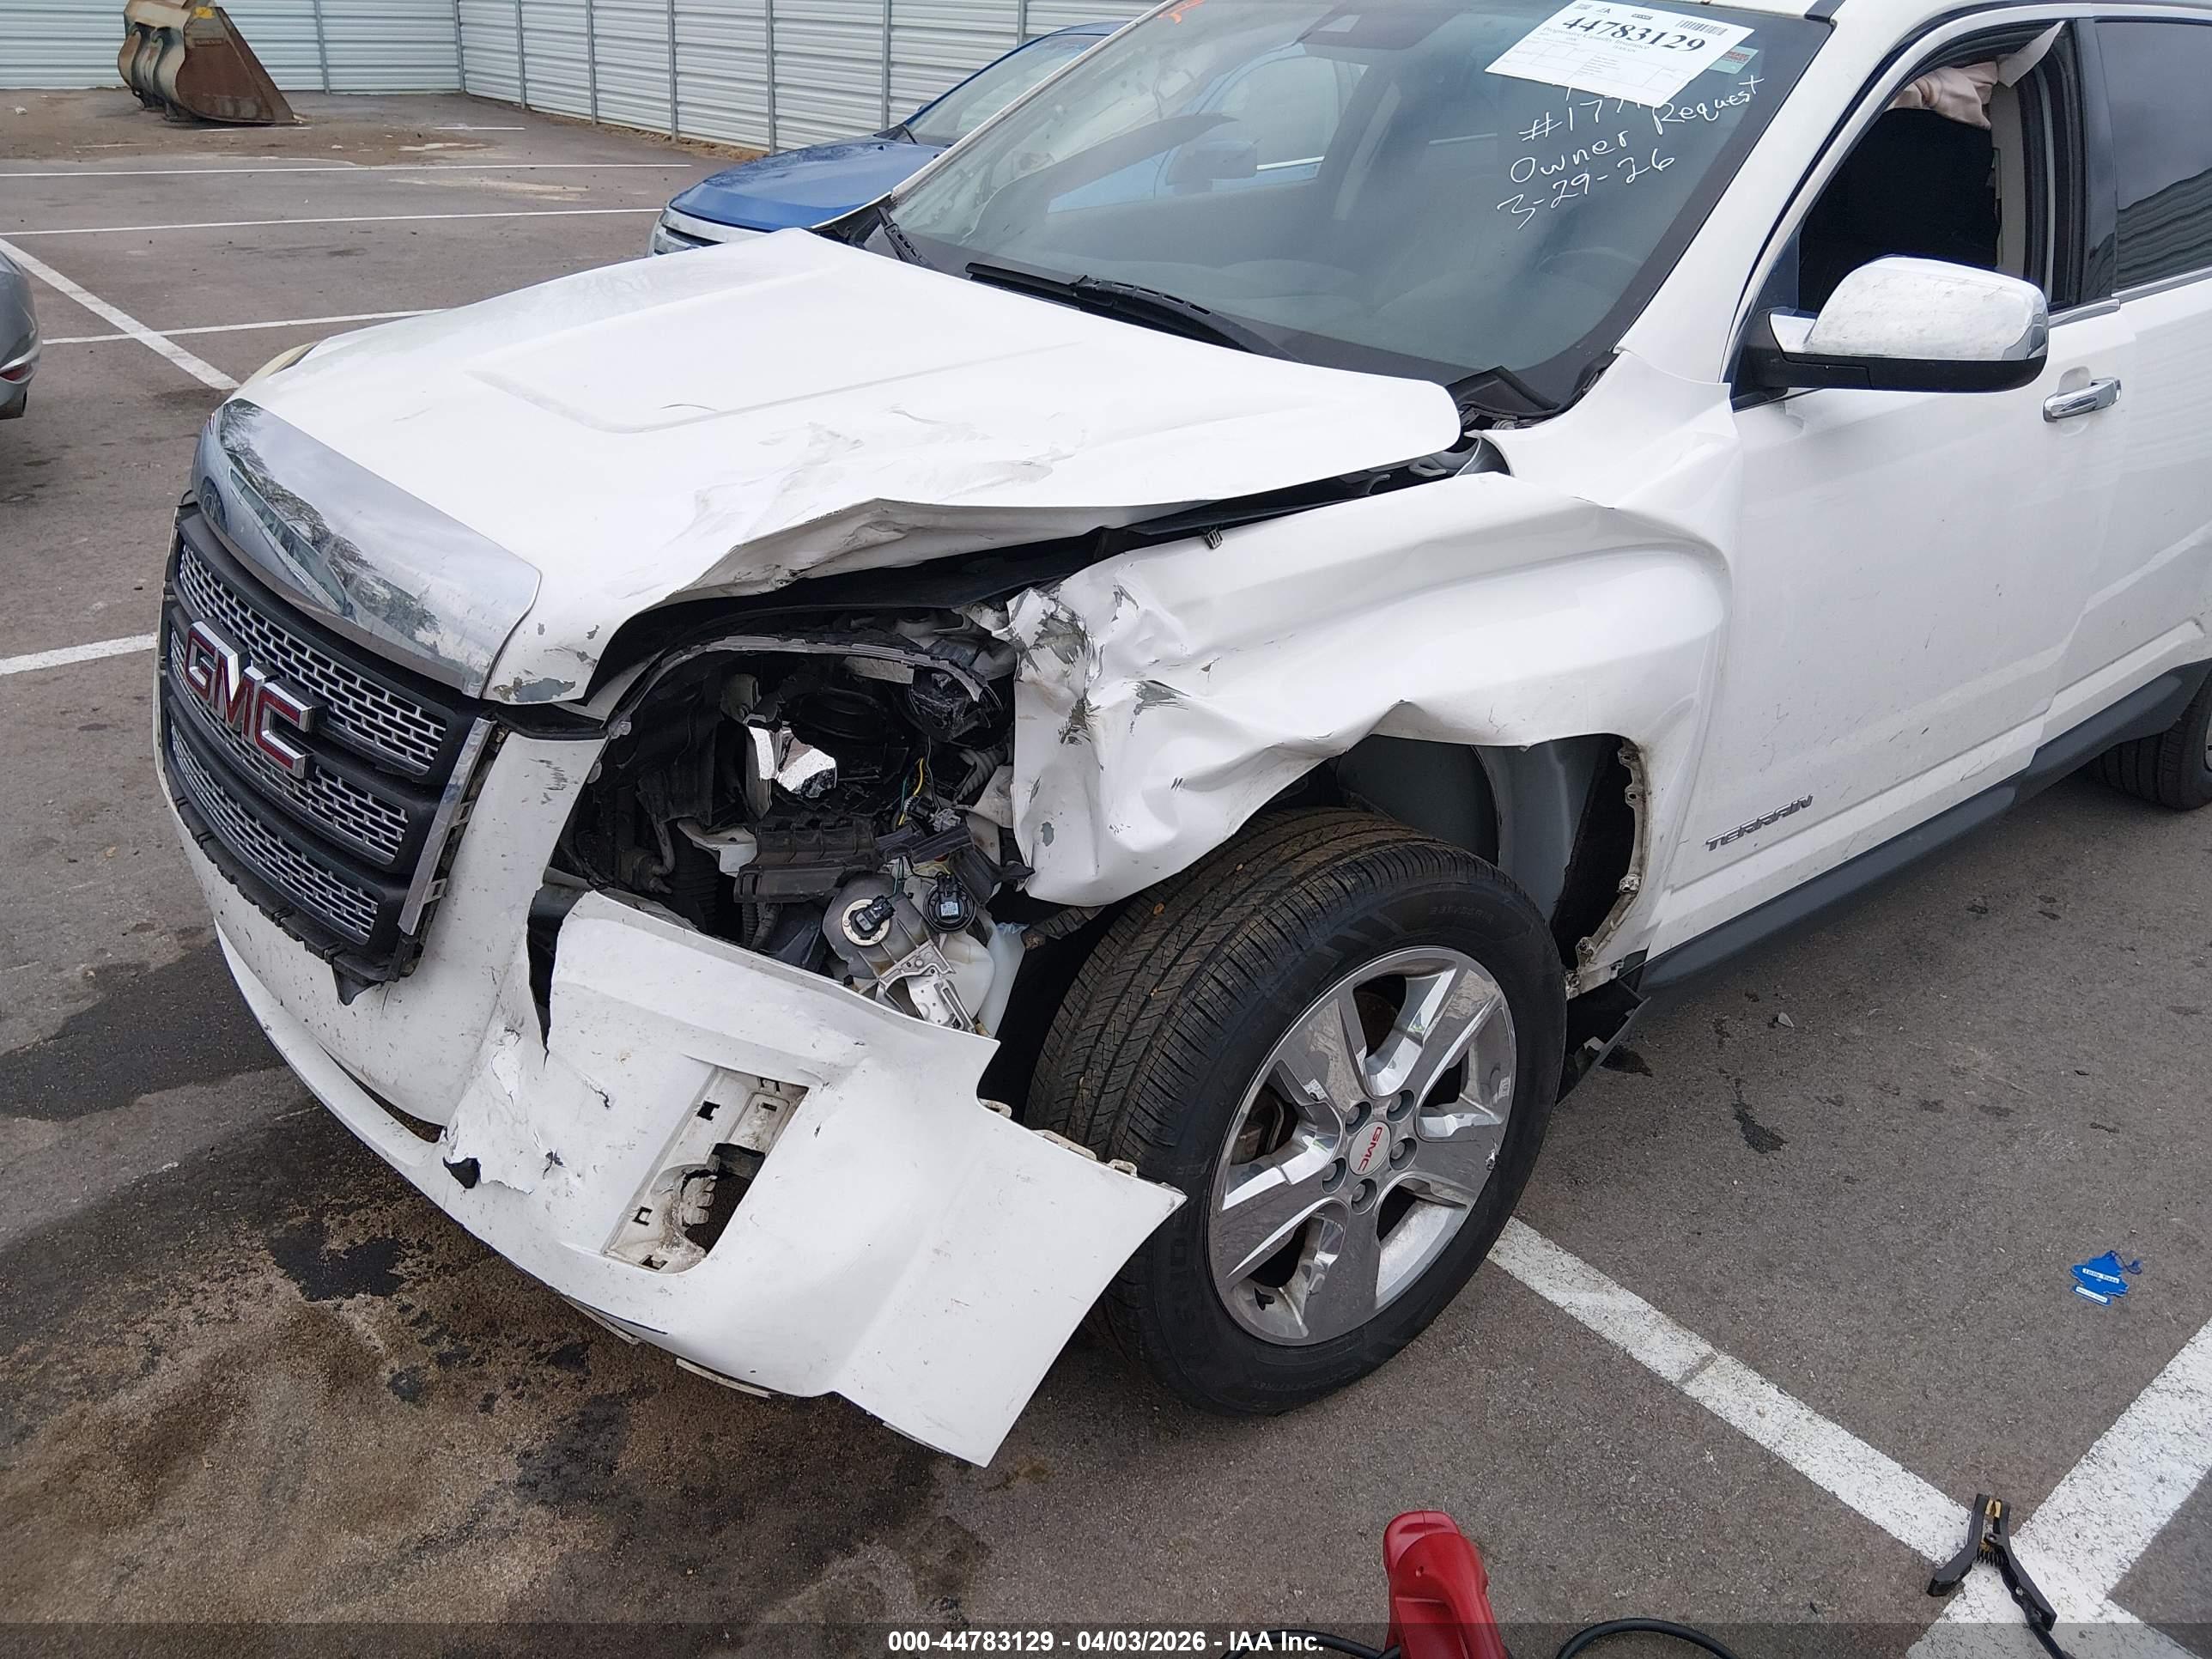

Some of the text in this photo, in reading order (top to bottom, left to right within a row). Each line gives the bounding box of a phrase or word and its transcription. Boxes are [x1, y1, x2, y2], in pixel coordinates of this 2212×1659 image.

[1562, 16, 1706, 52] 44783129
[1510, 75, 1765, 183] Owner Request
[1497, 148, 1675, 230] 3-29-26
[185, 620, 313, 780] GMC
[1705, 793, 1814, 852] TERRAIN
[1357, 1126, 1383, 1172] GMC
